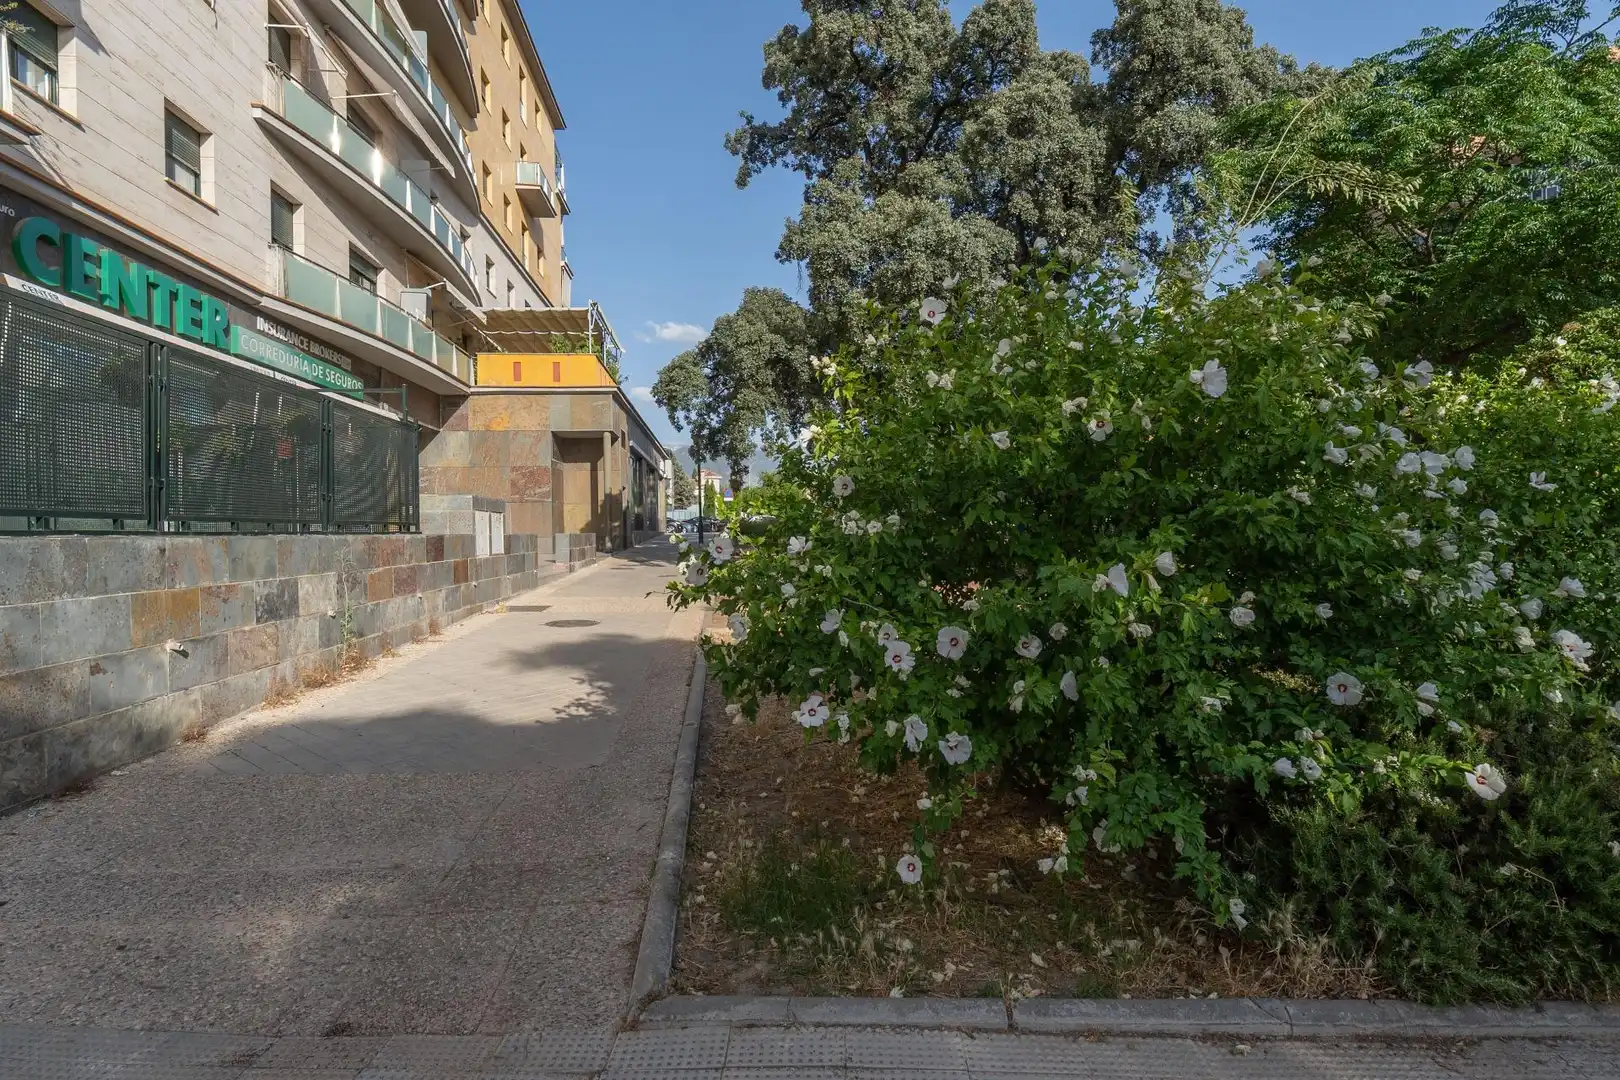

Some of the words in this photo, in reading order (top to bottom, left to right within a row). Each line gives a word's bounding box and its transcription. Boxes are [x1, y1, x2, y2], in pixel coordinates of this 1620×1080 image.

[12, 216, 230, 350] CENTER
[241, 334, 310, 374] CORREDURÍA
[311, 363, 323, 378] DE
[325, 368, 363, 393] SEGUROS
[256, 316, 309, 350] INSURANCE
[309, 340, 342, 365] BROKERS
